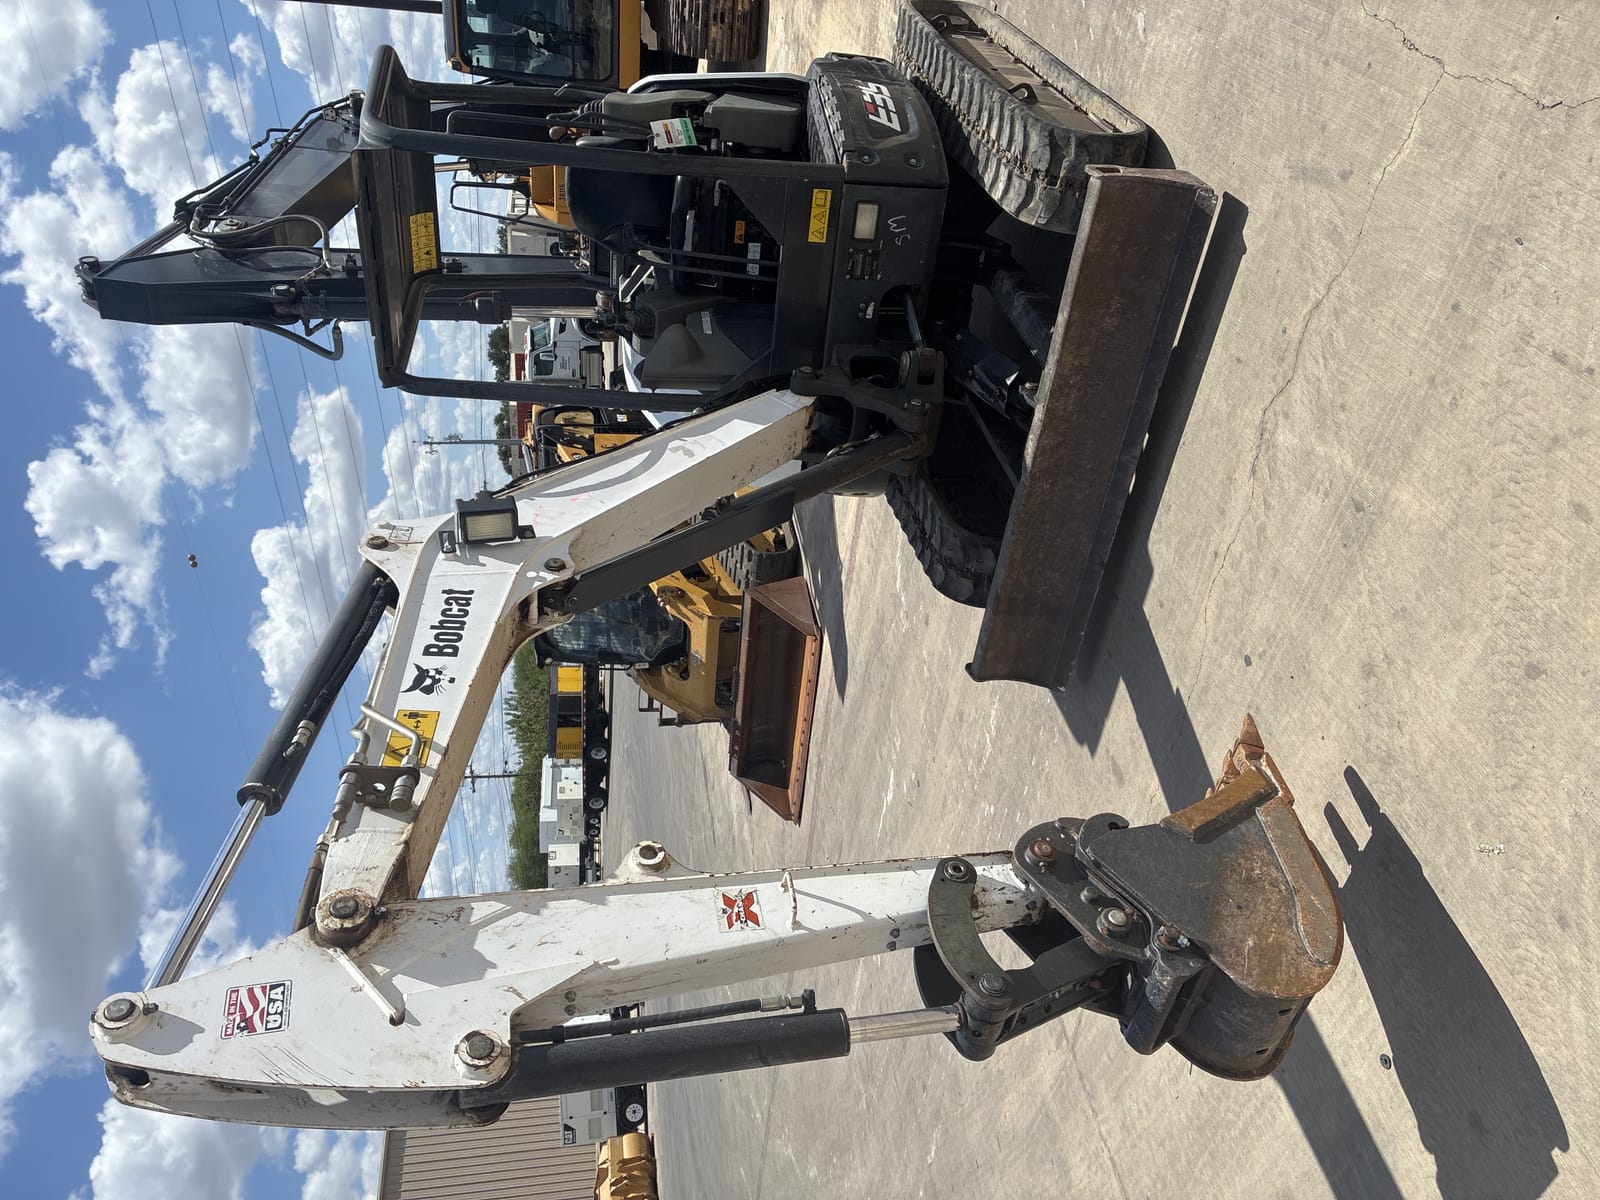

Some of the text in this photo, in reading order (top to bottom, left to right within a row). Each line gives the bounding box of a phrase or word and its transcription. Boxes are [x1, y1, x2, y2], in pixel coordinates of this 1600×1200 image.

[887, 215, 911, 246] SM
[421, 588, 475, 658] Bobcat
[228, 1005, 236, 1013] IN
[230, 992, 238, 1004] THE
[266, 986, 284, 1029] USA
